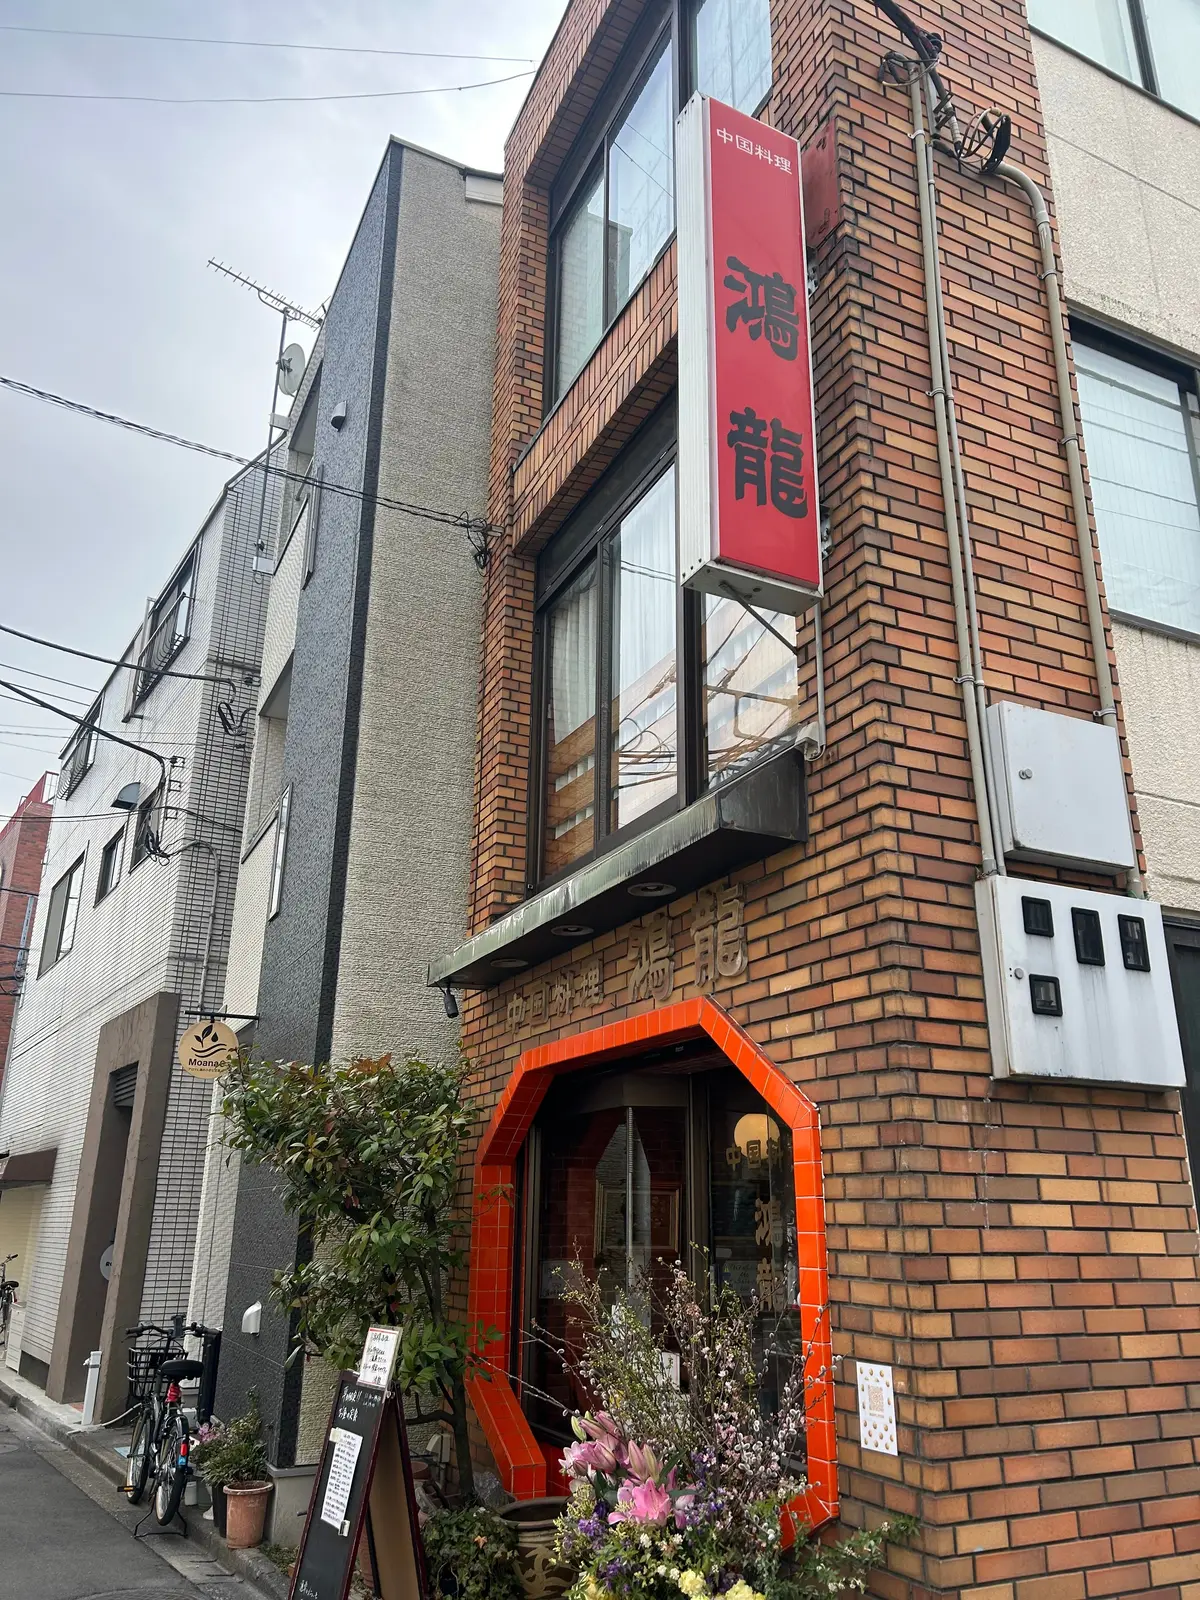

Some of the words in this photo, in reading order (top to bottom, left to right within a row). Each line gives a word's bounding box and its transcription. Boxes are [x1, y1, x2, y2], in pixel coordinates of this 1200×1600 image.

[716, 128, 792, 174] 中国料理
[725, 254, 808, 518] 鴻龍
[507, 957, 604, 1034] 中国料理
[627, 882, 748, 1002] 鴻龍
